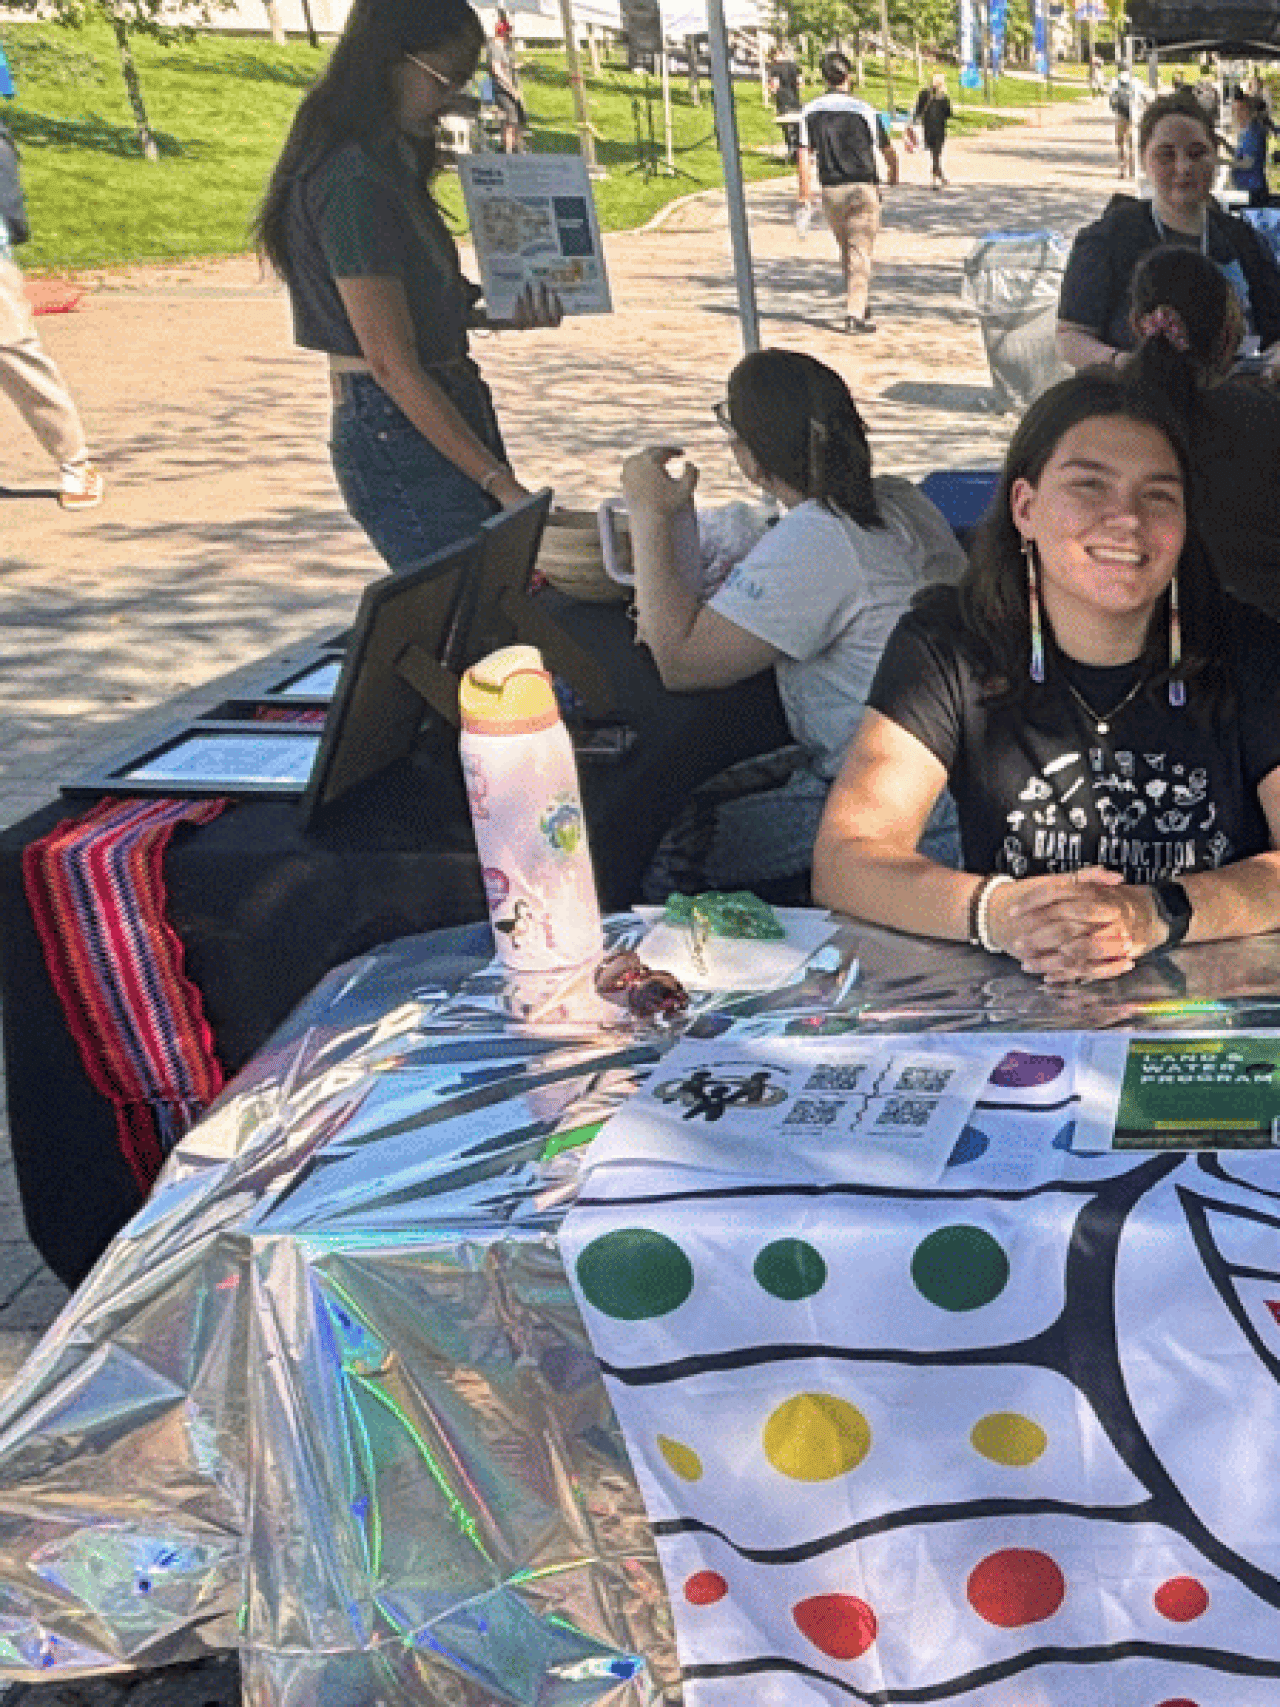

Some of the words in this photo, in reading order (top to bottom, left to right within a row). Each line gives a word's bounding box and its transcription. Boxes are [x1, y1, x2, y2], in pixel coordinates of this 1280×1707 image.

[1143, 1053, 1218, 1062] LAND
[1141, 1063, 1236, 1073] WATER
[1140, 1074, 1273, 1085] PROGRAM
